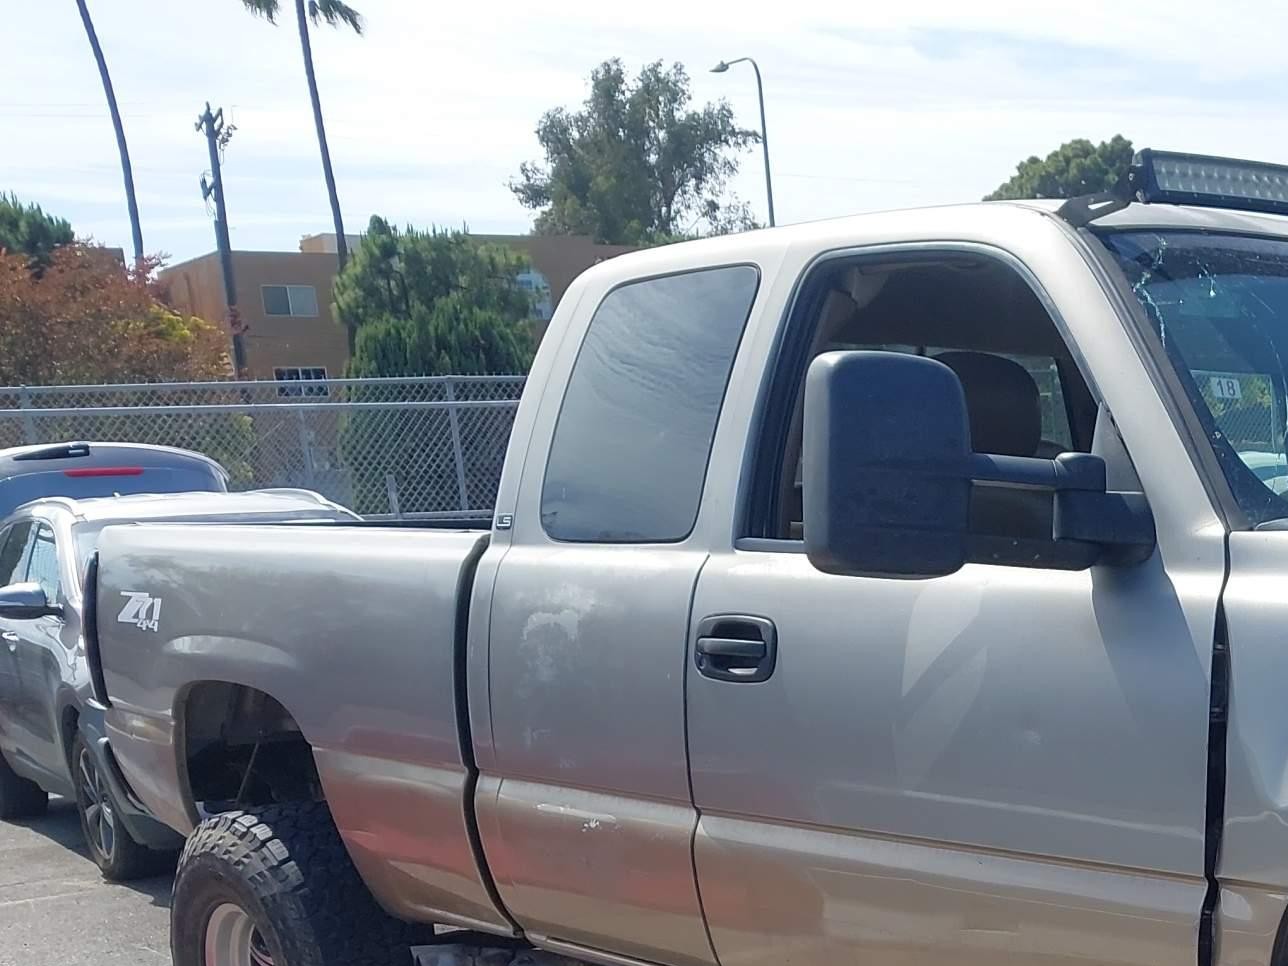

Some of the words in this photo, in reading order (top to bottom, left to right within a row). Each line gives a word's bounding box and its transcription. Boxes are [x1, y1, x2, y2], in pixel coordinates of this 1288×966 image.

[1216, 379, 1236, 397] 18
[496, 516, 512, 527] LS
[117, 591, 162, 623] Z71
